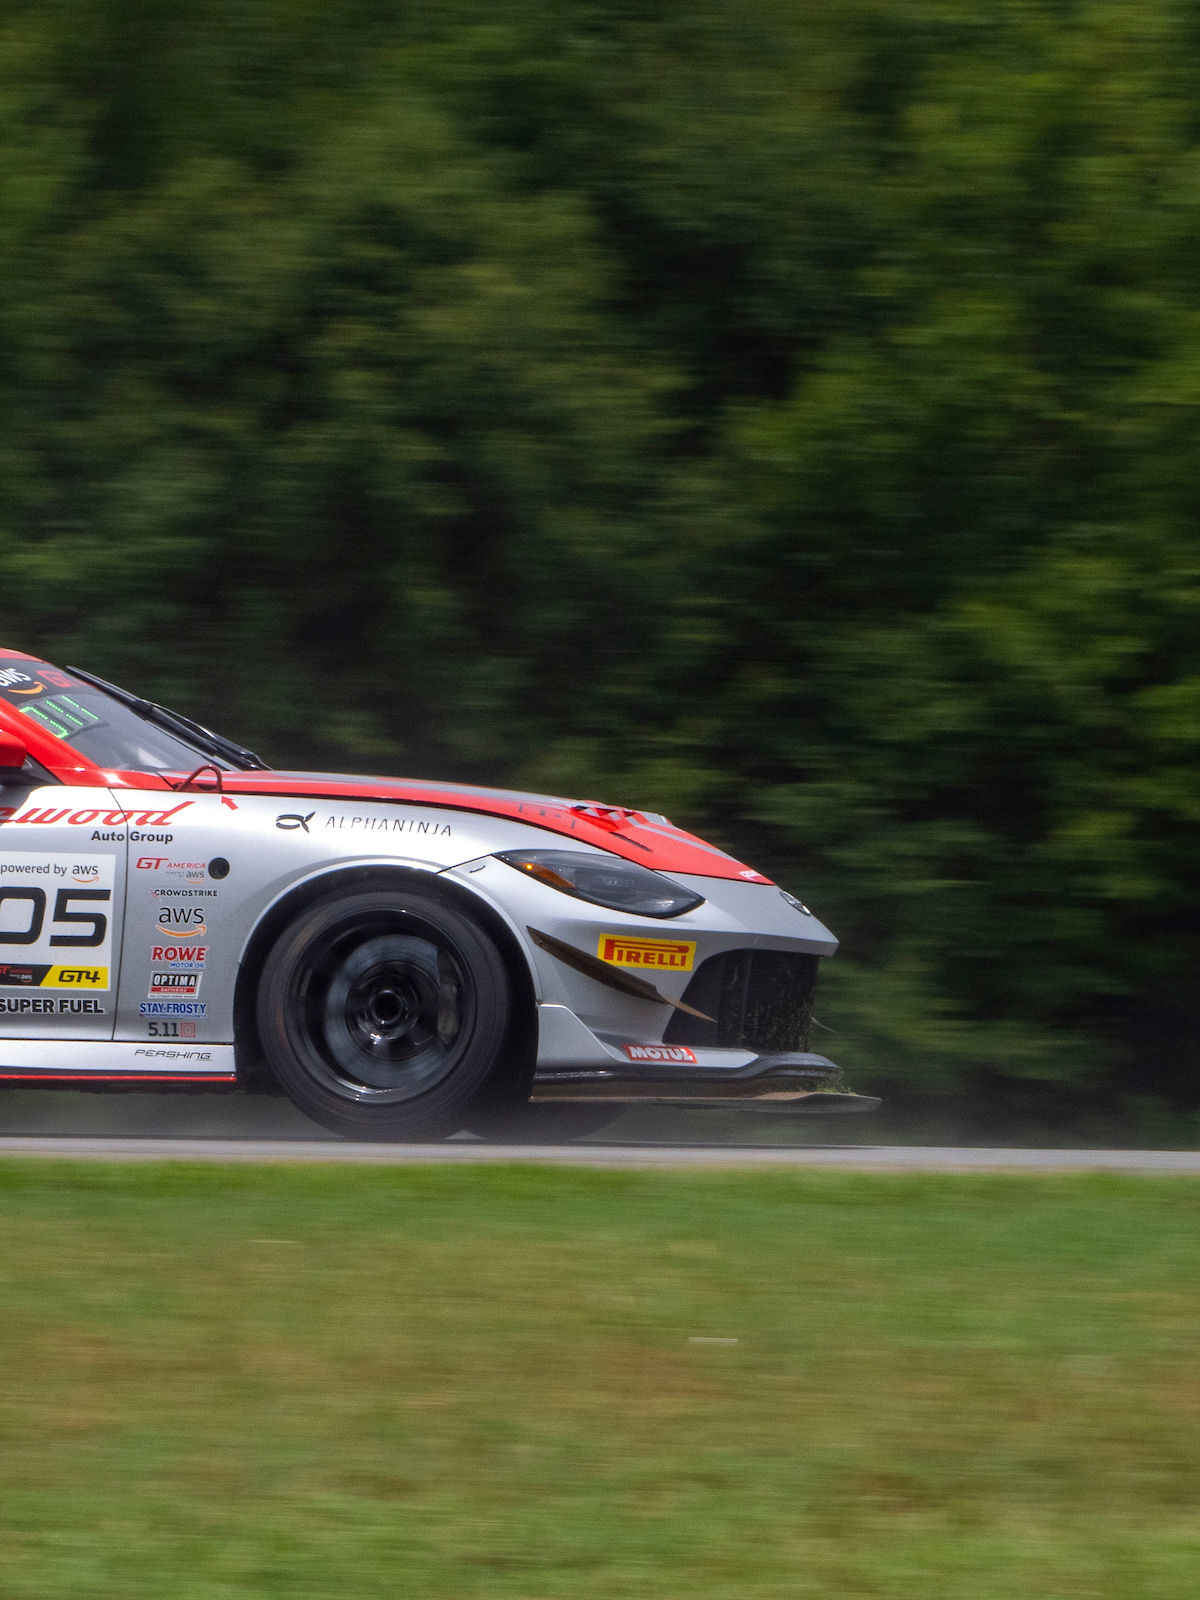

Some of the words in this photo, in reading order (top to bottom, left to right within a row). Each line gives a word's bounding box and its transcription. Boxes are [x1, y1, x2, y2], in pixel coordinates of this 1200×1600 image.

[325, 816, 452, 837] ALPHANINJA
[91, 831, 125, 842] Auto
[129, 832, 174, 844] Group
[0, 864, 50, 875] powered
[53, 864, 67, 876] by
[72, 865, 99, 875] aws
[136, 857, 169, 870] GT
[154, 889, 218, 897] CROWDSTRIKE
[159, 907, 204, 924] aws
[152, 947, 206, 961] ROWE
[604, 939, 690, 967] PIRELLI
[58, 970, 100, 983] GT4
[154, 975, 196, 986] OPTIMA
[59, 999, 104, 1014] FUEL
[140, 1002, 164, 1013] STAY
[166, 1003, 207, 1013] FROSTY
[148, 1022, 180, 1037] 5.11
[134, 1049, 212, 1060] PERSHING
[629, 1047, 694, 1062] MOTUL
